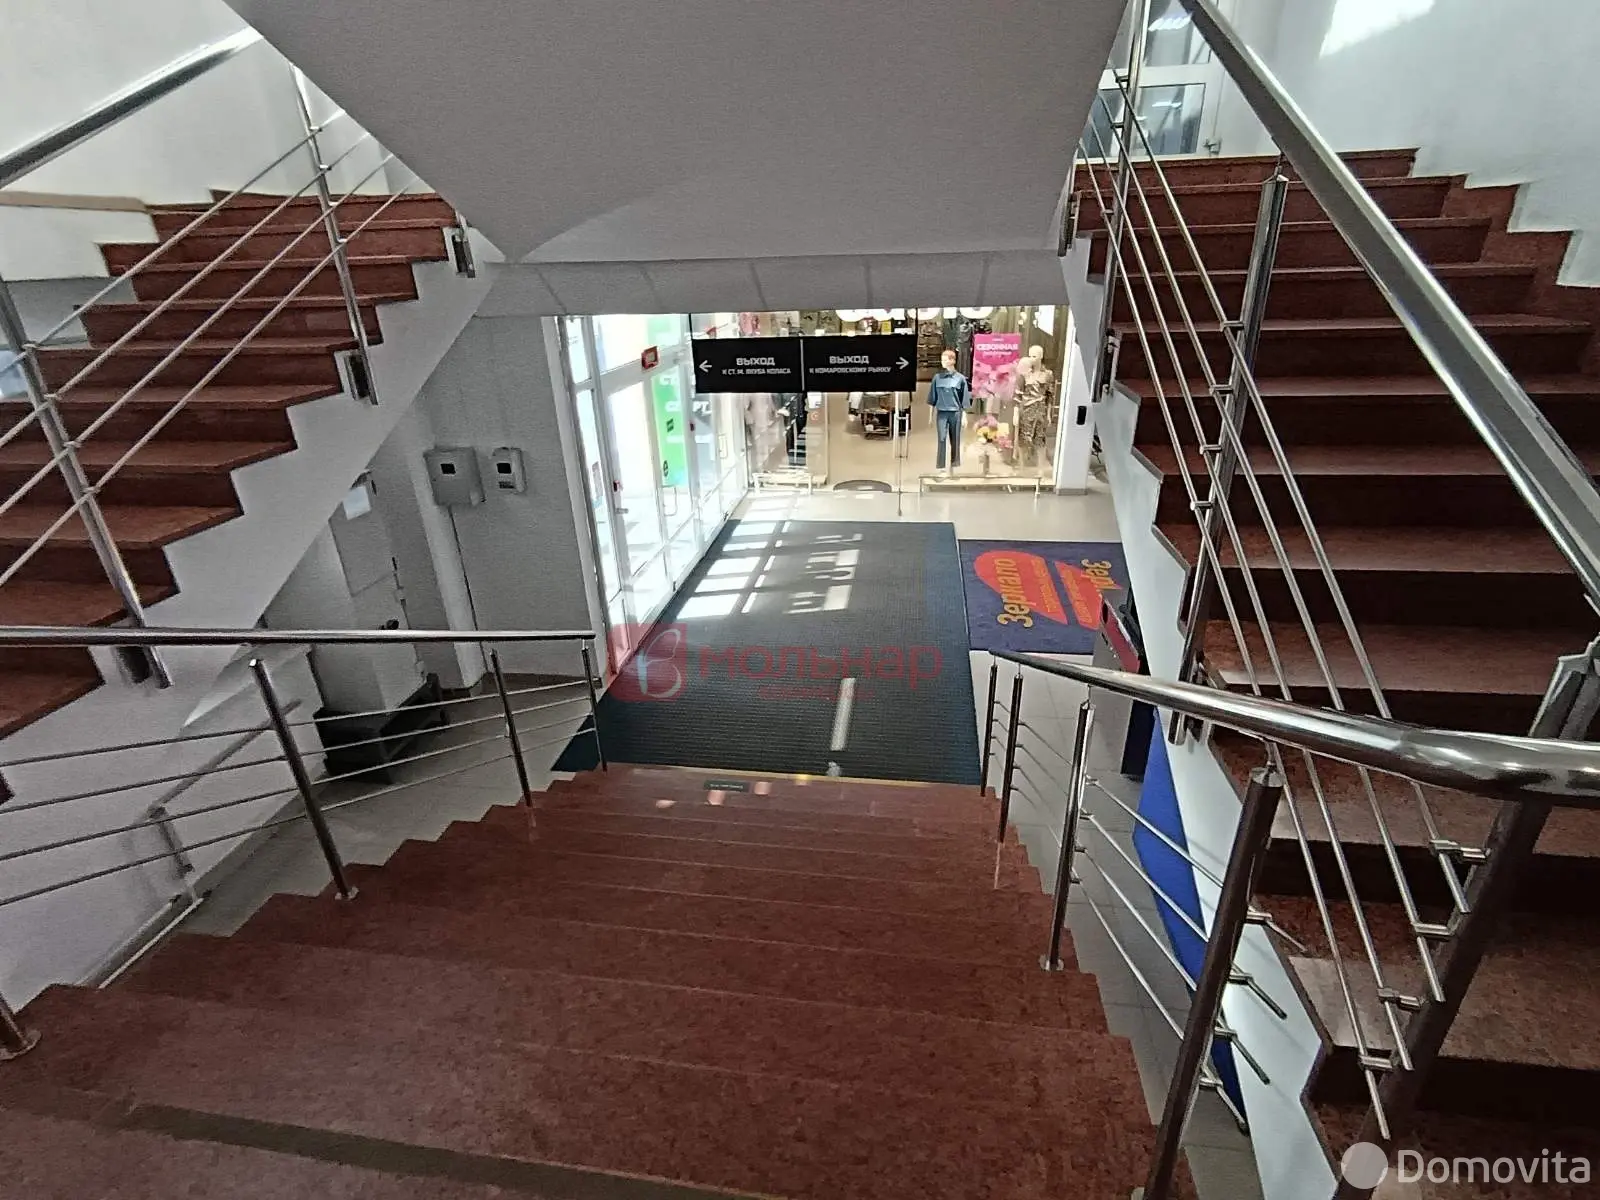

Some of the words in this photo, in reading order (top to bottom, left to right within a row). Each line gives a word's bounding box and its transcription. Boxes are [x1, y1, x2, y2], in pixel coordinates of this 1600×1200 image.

[736, 357, 776, 366] ВЫХОД
[829, 355, 870, 364] ВЫХОД
[993, 558, 1037, 629] Зеркало
